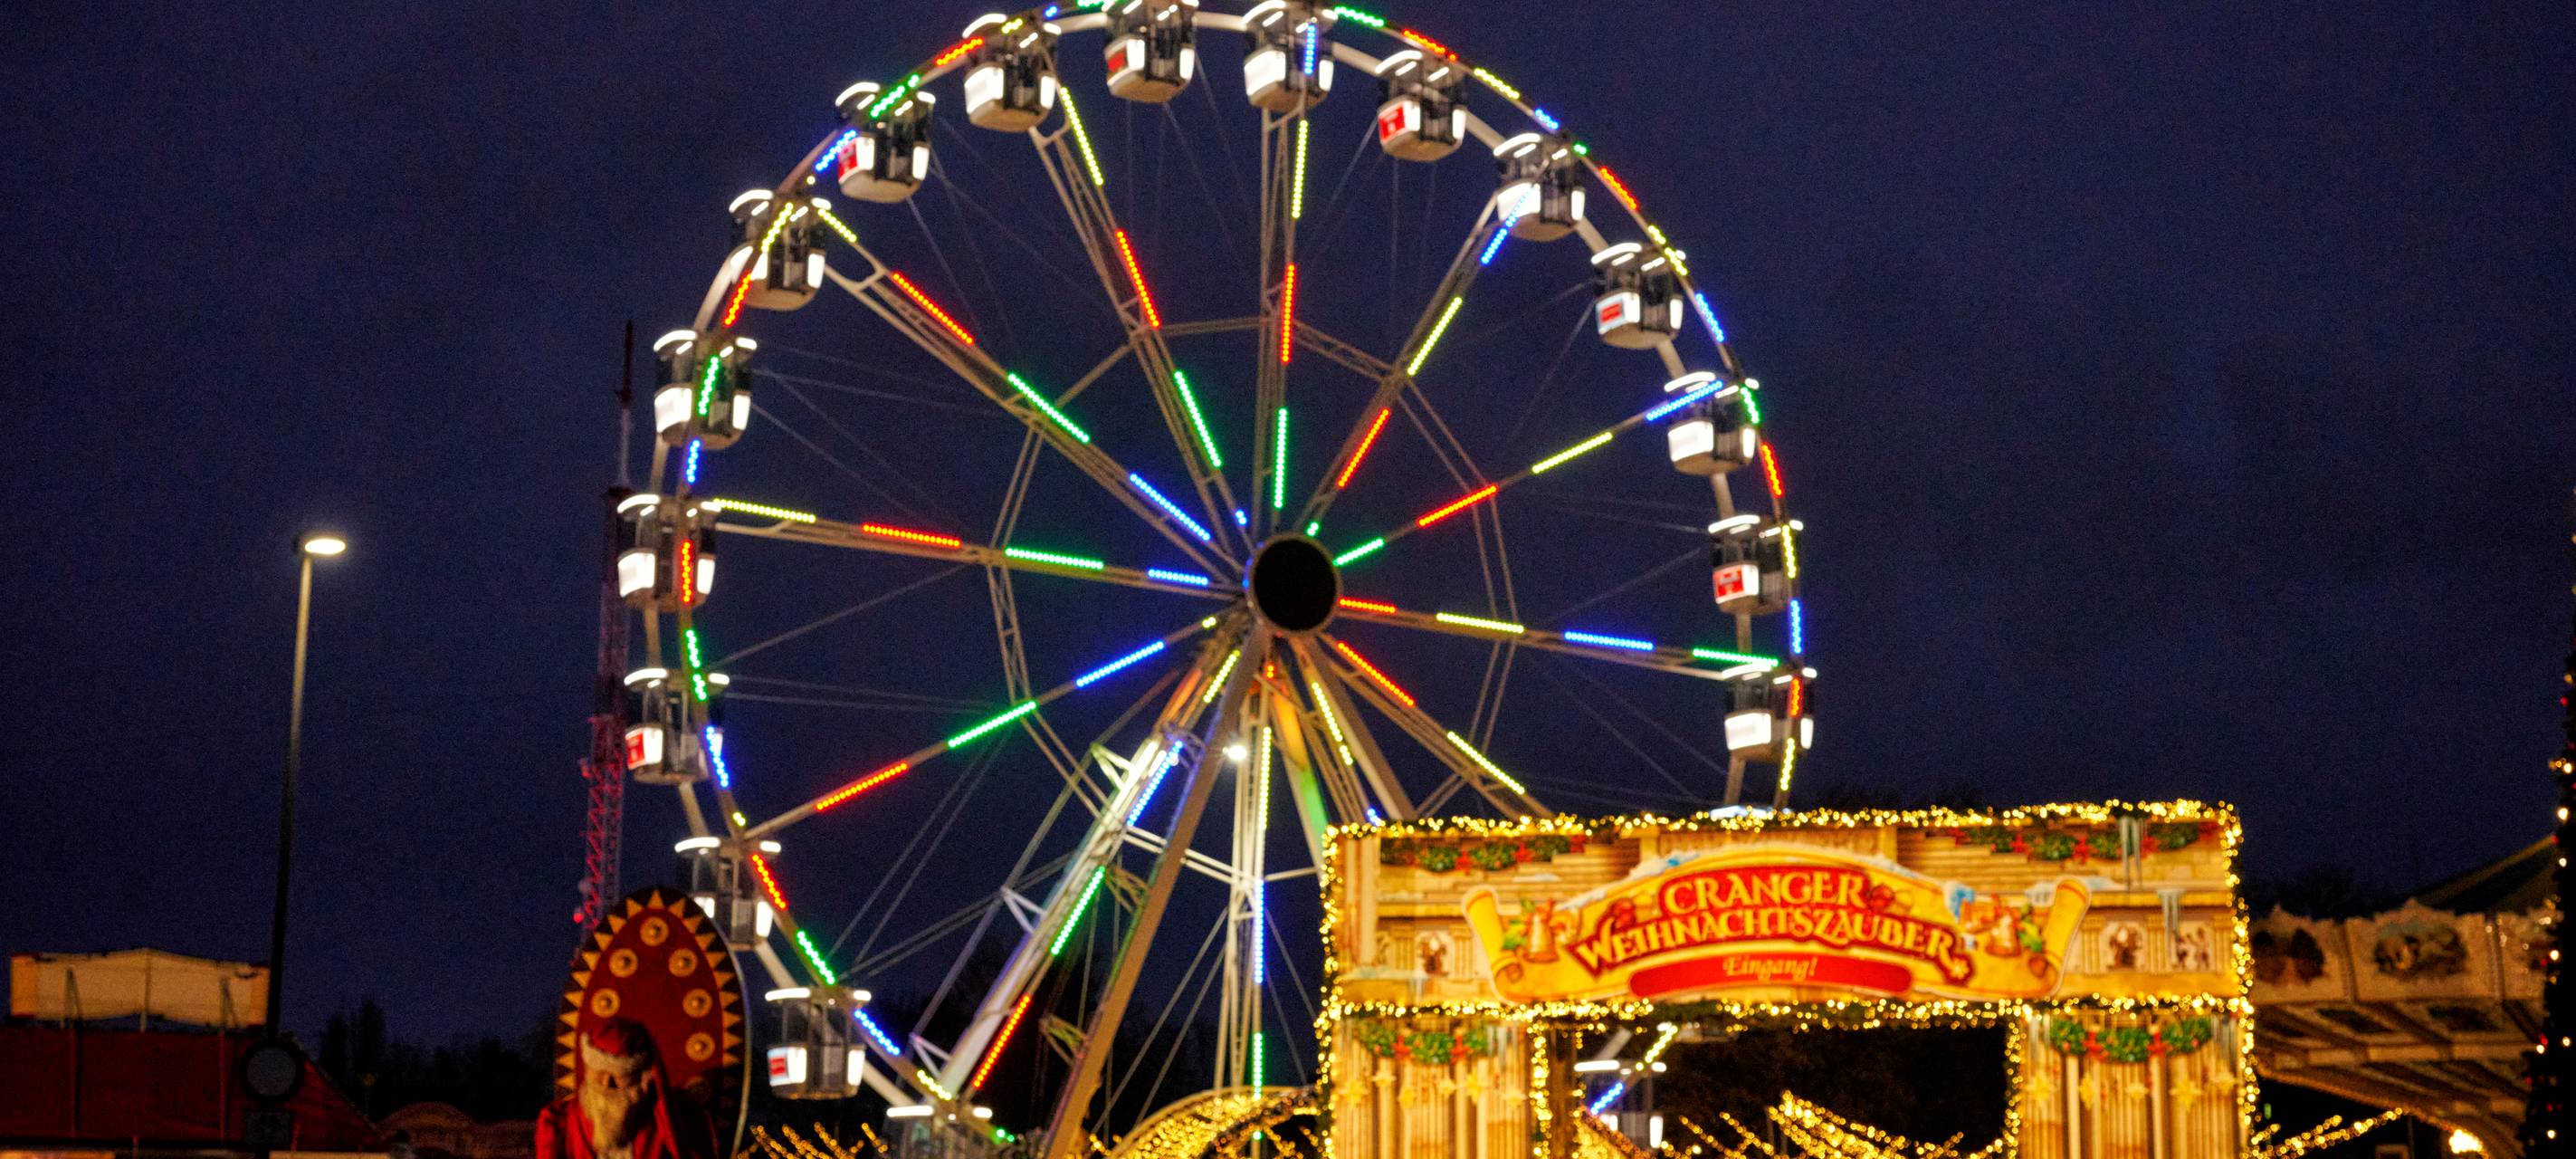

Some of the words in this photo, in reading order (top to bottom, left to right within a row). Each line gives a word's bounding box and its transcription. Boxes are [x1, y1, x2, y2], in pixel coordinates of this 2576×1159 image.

[1665, 873, 1866, 915] CRANGER
[1577, 906, 1960, 970] WEIHNACHTSZAUBER
[1722, 955, 1818, 982] Eingang!
